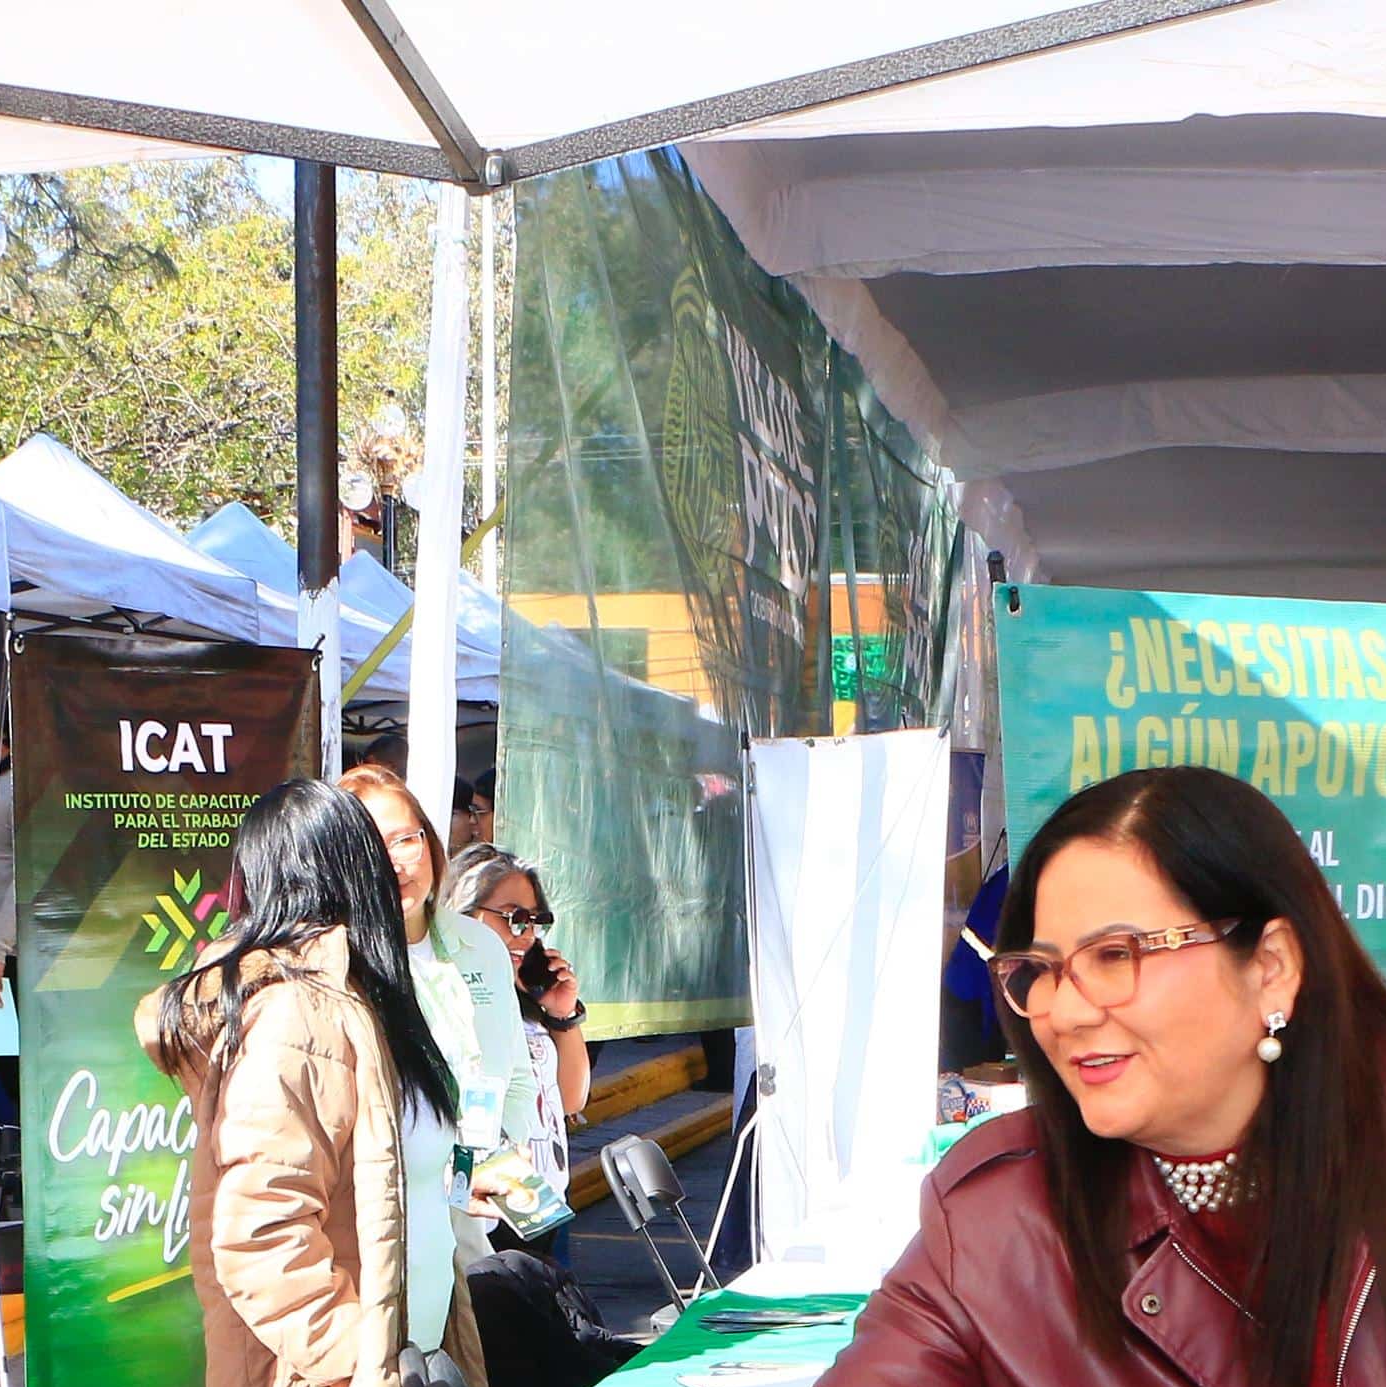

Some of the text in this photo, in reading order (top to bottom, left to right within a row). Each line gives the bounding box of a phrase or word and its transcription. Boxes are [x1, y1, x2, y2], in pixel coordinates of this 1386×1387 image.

[119, 719, 233, 773] ICAT
[65, 793, 262, 810] INSTITUTO DE CAPACITAC
[114, 813, 158, 829] PARA
[162, 813, 180, 828] EL
[138, 832, 230, 849] DEL ESTADO
[464, 972, 485, 985] CAT
[49, 1069, 197, 1176] Capac
